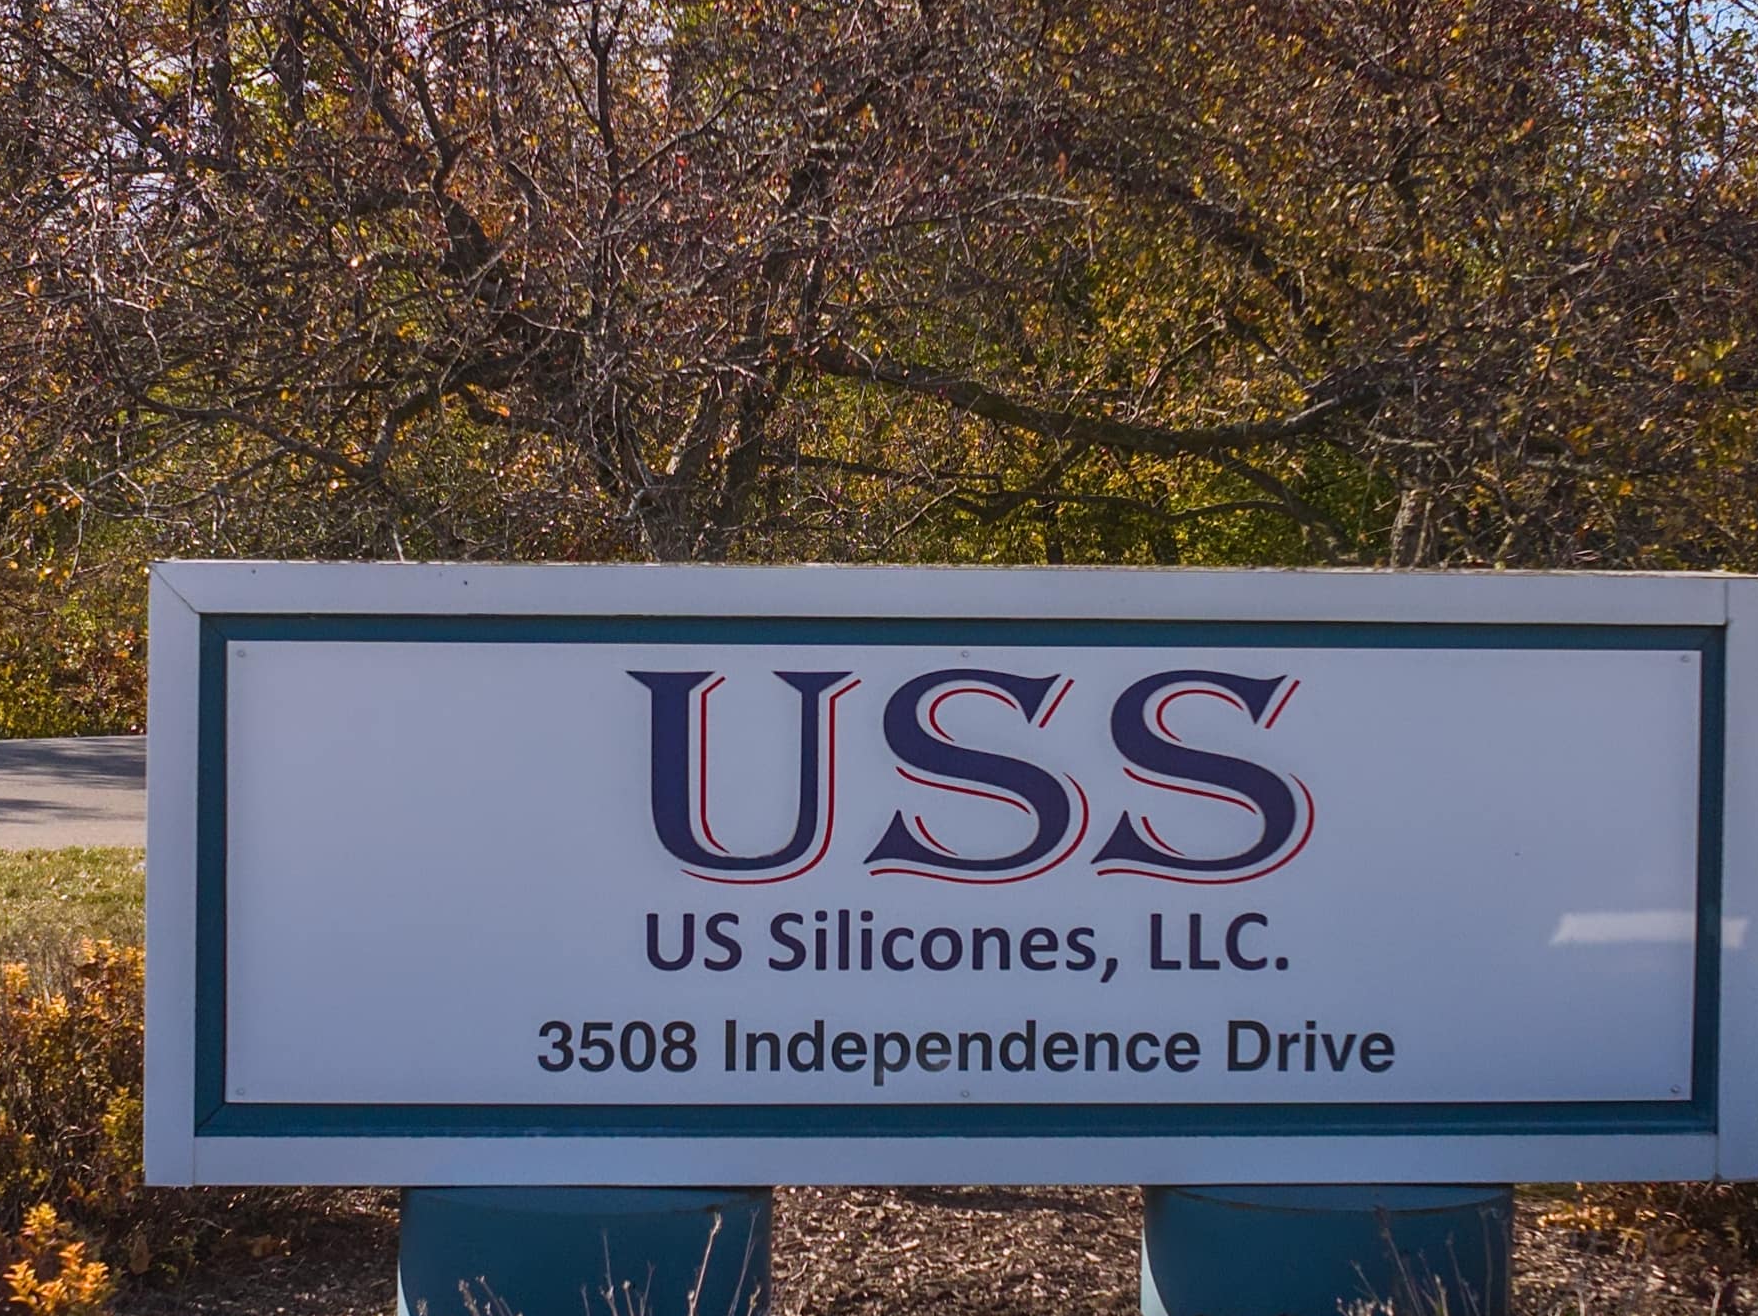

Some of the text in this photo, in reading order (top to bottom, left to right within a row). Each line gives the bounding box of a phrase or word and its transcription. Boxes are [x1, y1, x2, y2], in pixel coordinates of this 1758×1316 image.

[624, 668, 1316, 887] USS
[645, 908, 1290, 984] US Silicones, LLC.
[536, 1018, 1396, 1088] 3508 Independence Drive
